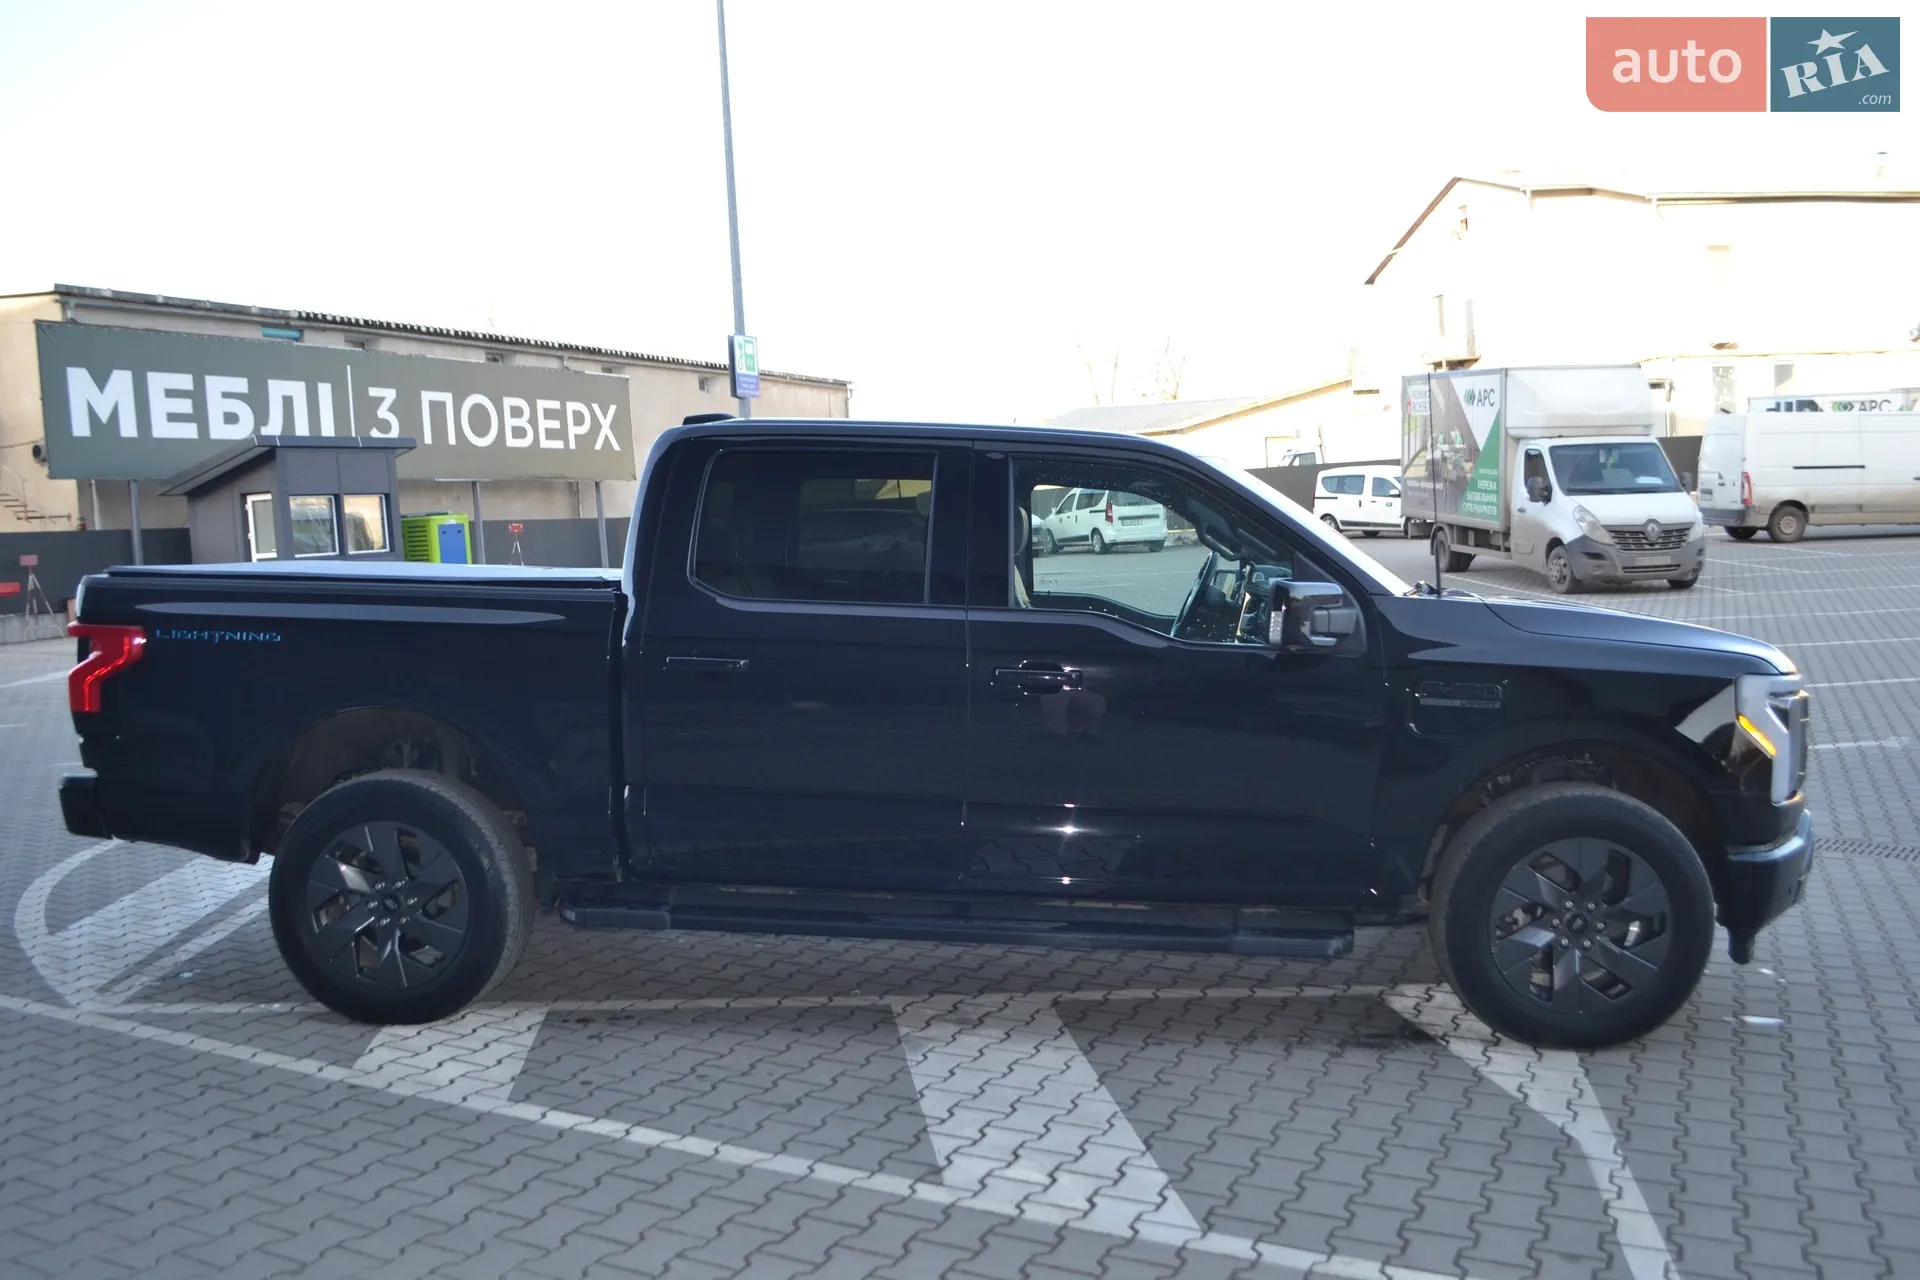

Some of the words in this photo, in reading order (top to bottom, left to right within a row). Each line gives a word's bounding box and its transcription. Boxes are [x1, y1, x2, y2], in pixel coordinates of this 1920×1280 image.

[66, 366, 336, 440] МЕБЛІ
[367, 386, 400, 439] 3
[420, 389, 621, 452] ПОВЕРХ
[156, 629, 281, 643] LIGHTNING
